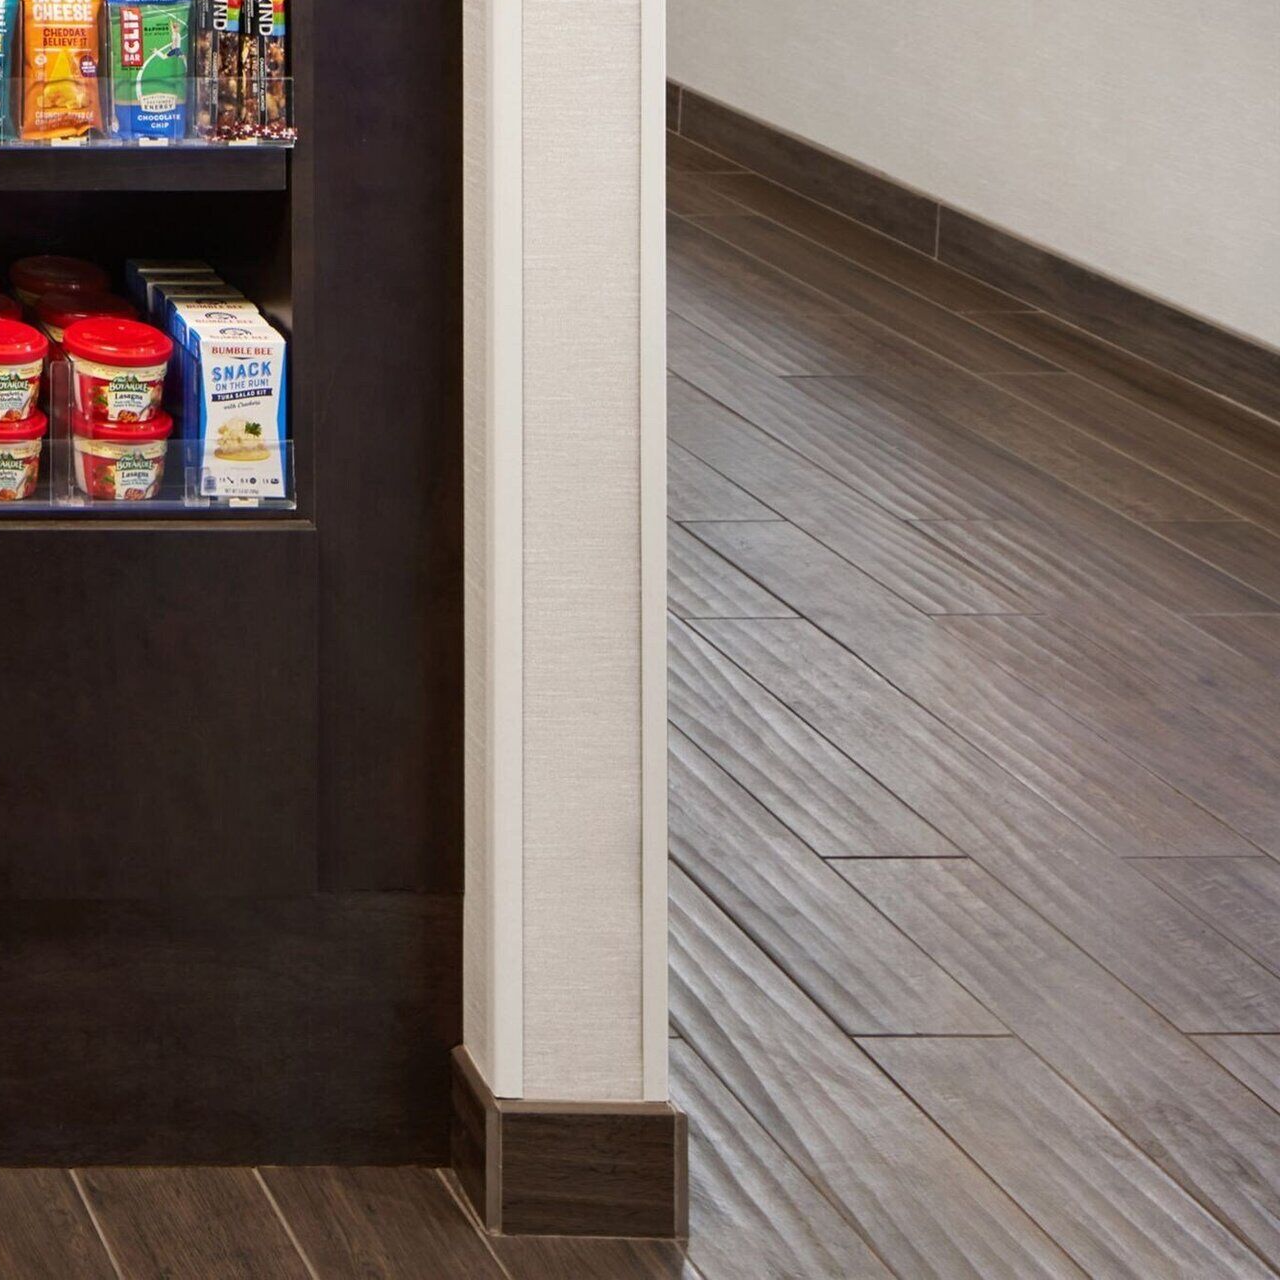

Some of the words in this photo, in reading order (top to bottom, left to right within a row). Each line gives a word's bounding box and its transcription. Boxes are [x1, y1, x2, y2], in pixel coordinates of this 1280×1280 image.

[122, 10, 140, 53] CLIF
[212, 347, 251, 355] BUMBLE
[212, 361, 272, 382] SNACK
